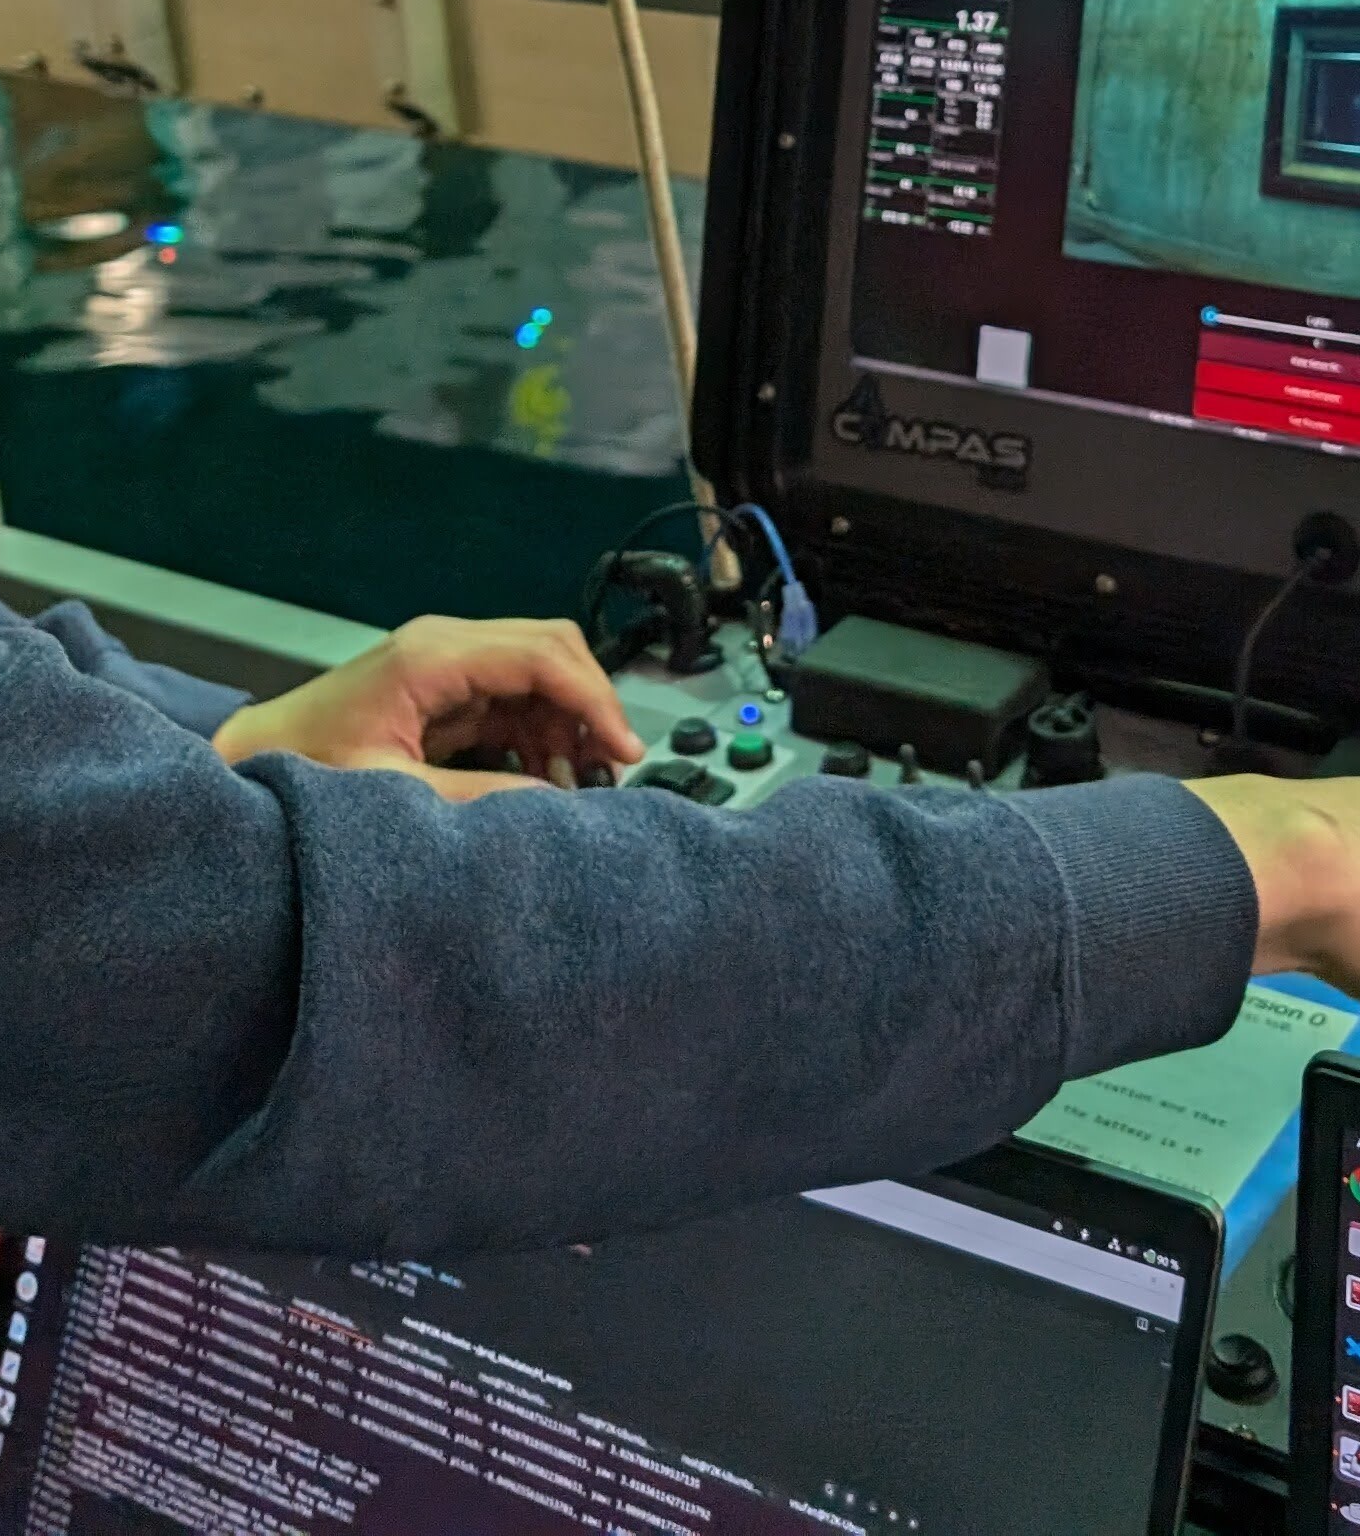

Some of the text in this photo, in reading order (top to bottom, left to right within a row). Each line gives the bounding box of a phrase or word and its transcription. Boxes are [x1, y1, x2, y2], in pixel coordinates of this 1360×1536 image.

[955, 9, 999, 33] 1.37
[1245, 995, 1305, 1020] rsion
[1094, 1113, 1153, 1142] battery
